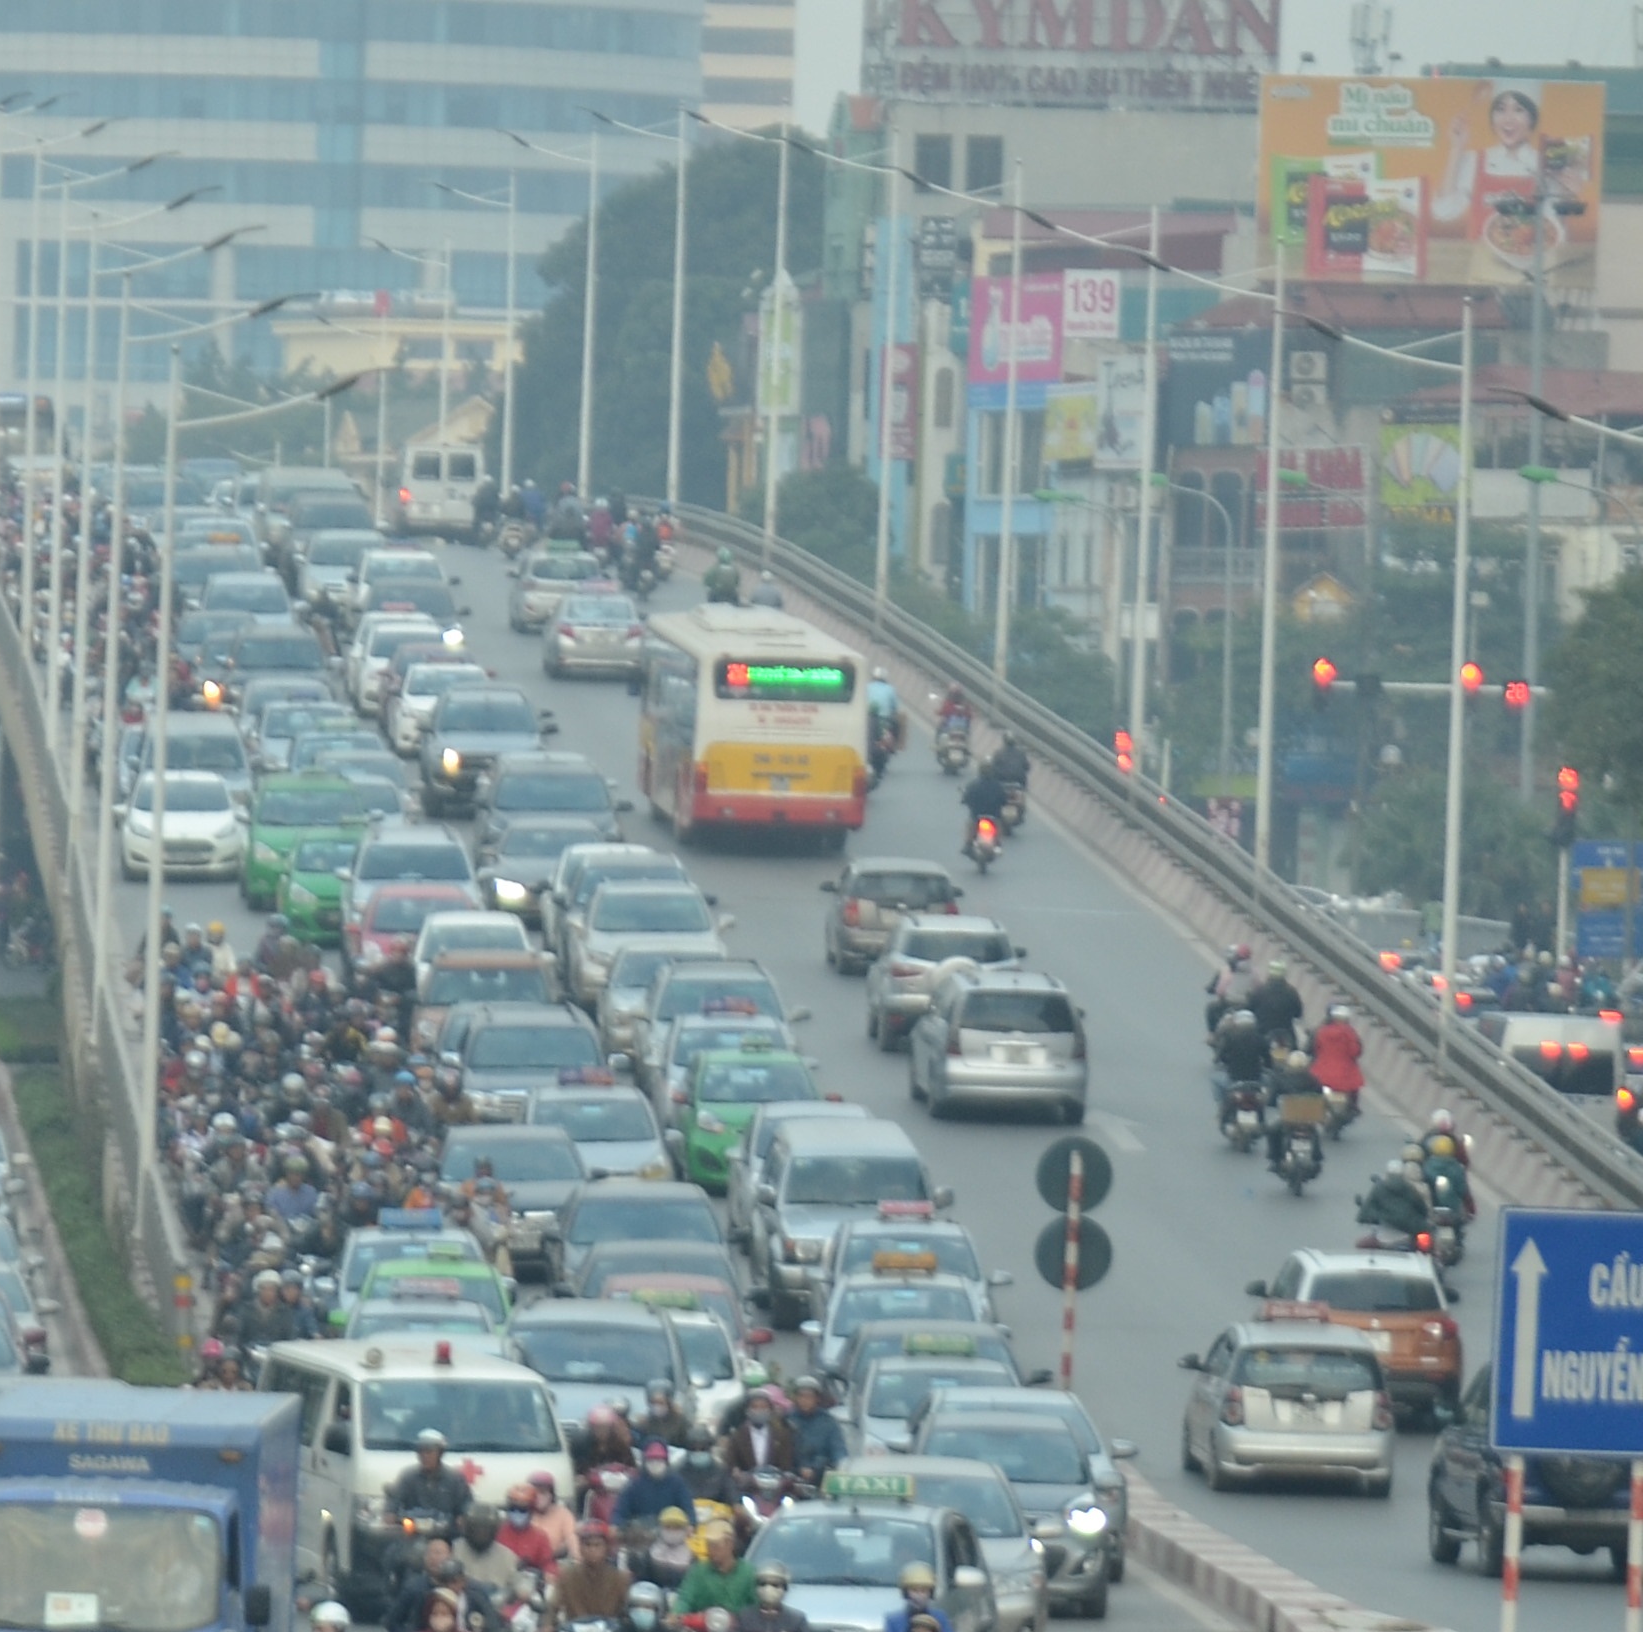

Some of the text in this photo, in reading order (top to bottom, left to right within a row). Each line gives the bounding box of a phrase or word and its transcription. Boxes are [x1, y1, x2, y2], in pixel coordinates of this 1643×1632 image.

[896, 0, 1279, 54] KYMDAN
[1069, 278, 1115, 314] 139
[68, 1453, 150, 1472] SAGAWA
[837, 1475, 899, 1491] TAXI
